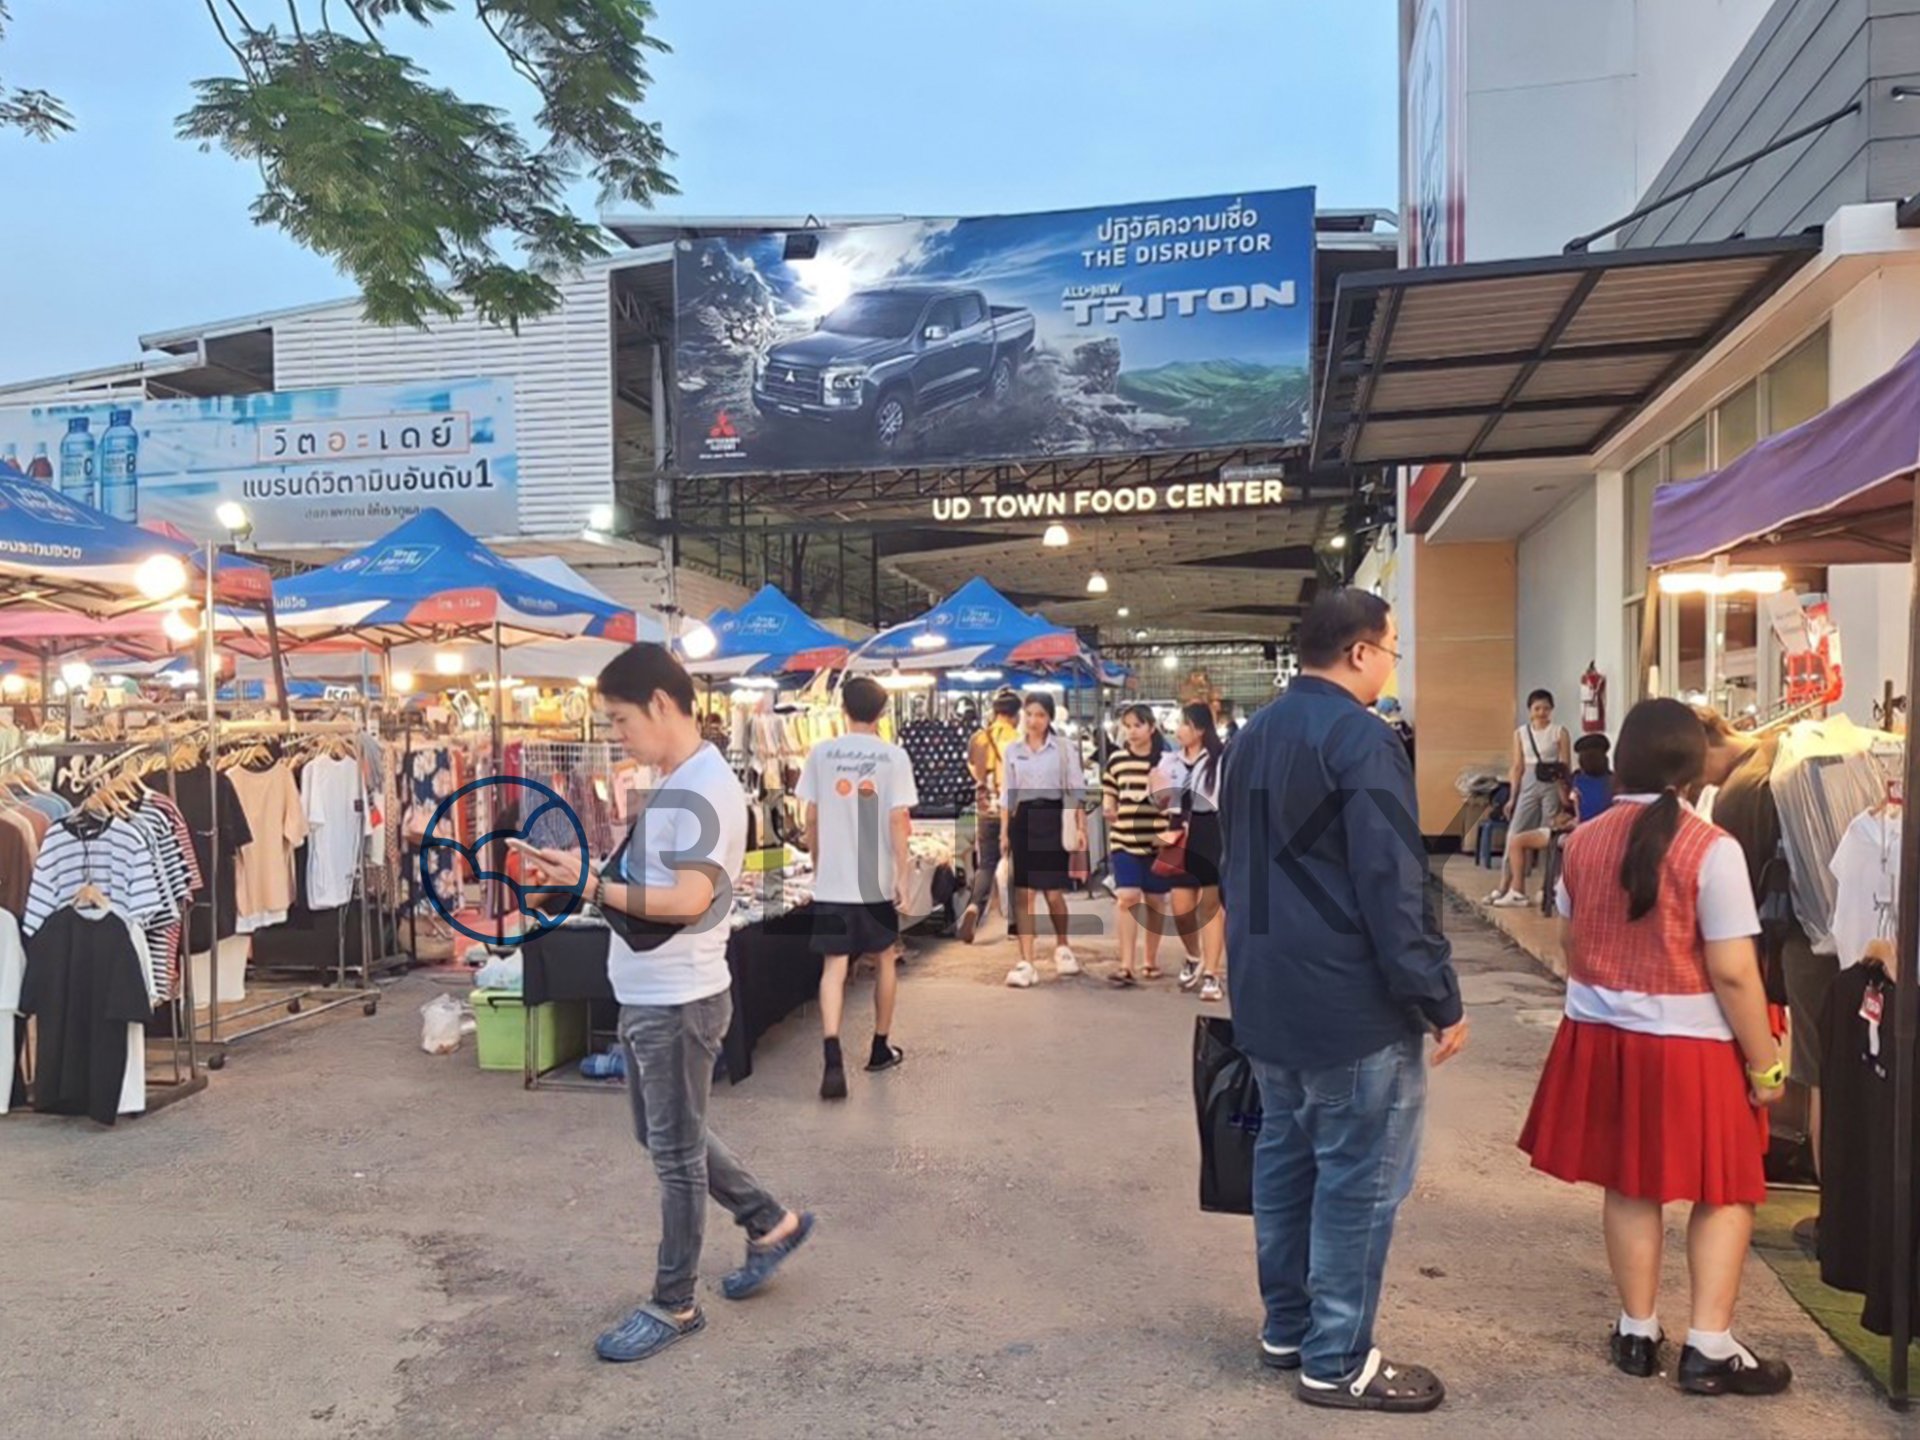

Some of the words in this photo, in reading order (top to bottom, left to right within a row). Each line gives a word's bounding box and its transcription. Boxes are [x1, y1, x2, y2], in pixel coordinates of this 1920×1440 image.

[1098, 198, 1258, 245] ปฏิวัติความเชื่อ
[1082, 248, 1127, 268] THE
[1136, 233, 1272, 264] DISRUPTOR
[1061, 280, 1296, 326] TRITON
[1063, 282, 1122, 299] ALL-NEW
[932, 497, 971, 521] UD
[980, 492, 1067, 518] TOWN
[1074, 488, 1158, 513] FOOD
[1166, 480, 1283, 508] CENTER
